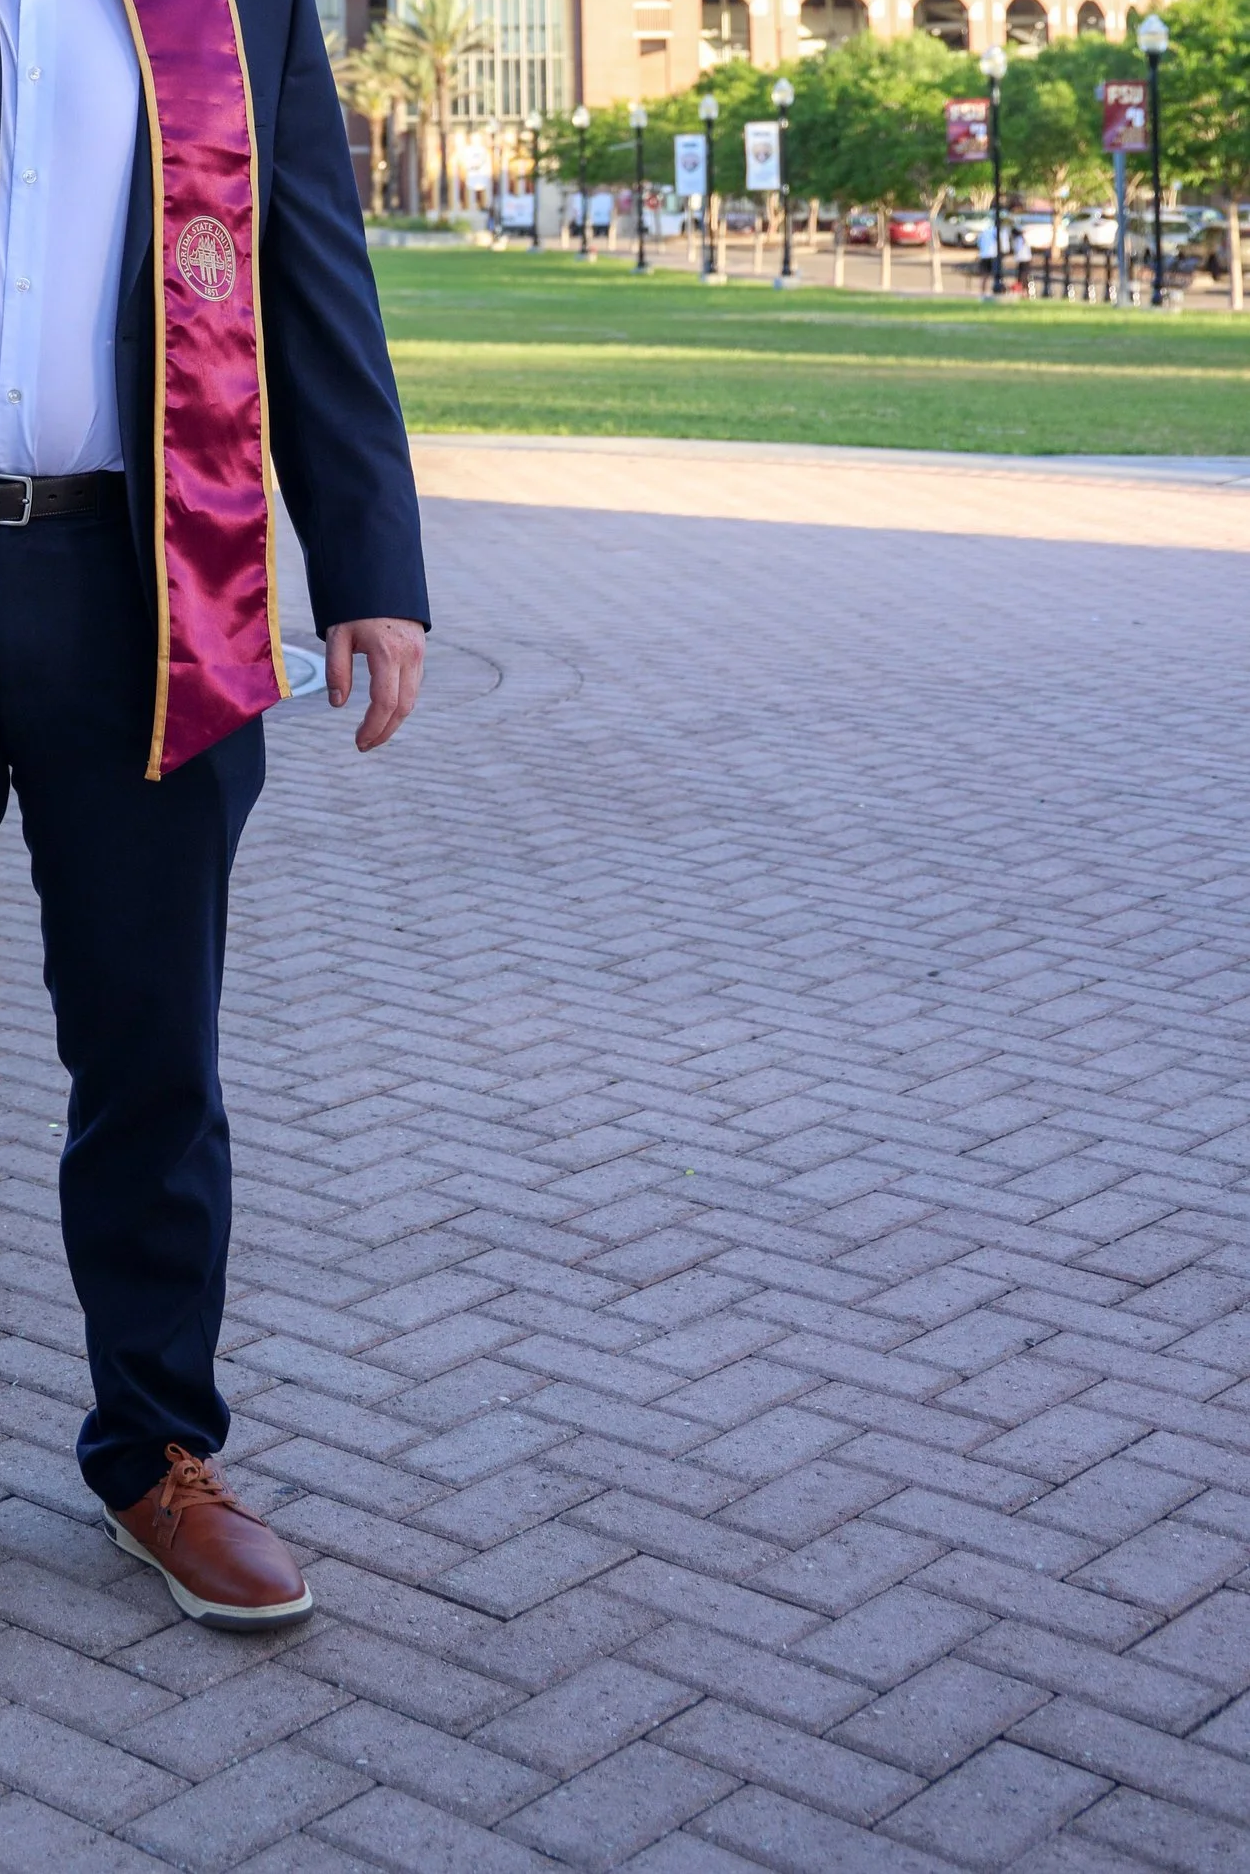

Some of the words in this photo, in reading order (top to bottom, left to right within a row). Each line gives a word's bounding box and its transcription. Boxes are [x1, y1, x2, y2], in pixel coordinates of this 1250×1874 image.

[180, 233, 192, 279] FLORIDA
[191, 222, 214, 235] STATE
[214, 227, 232, 285] UNIVERSITY
[204, 286, 219, 297] 1851
